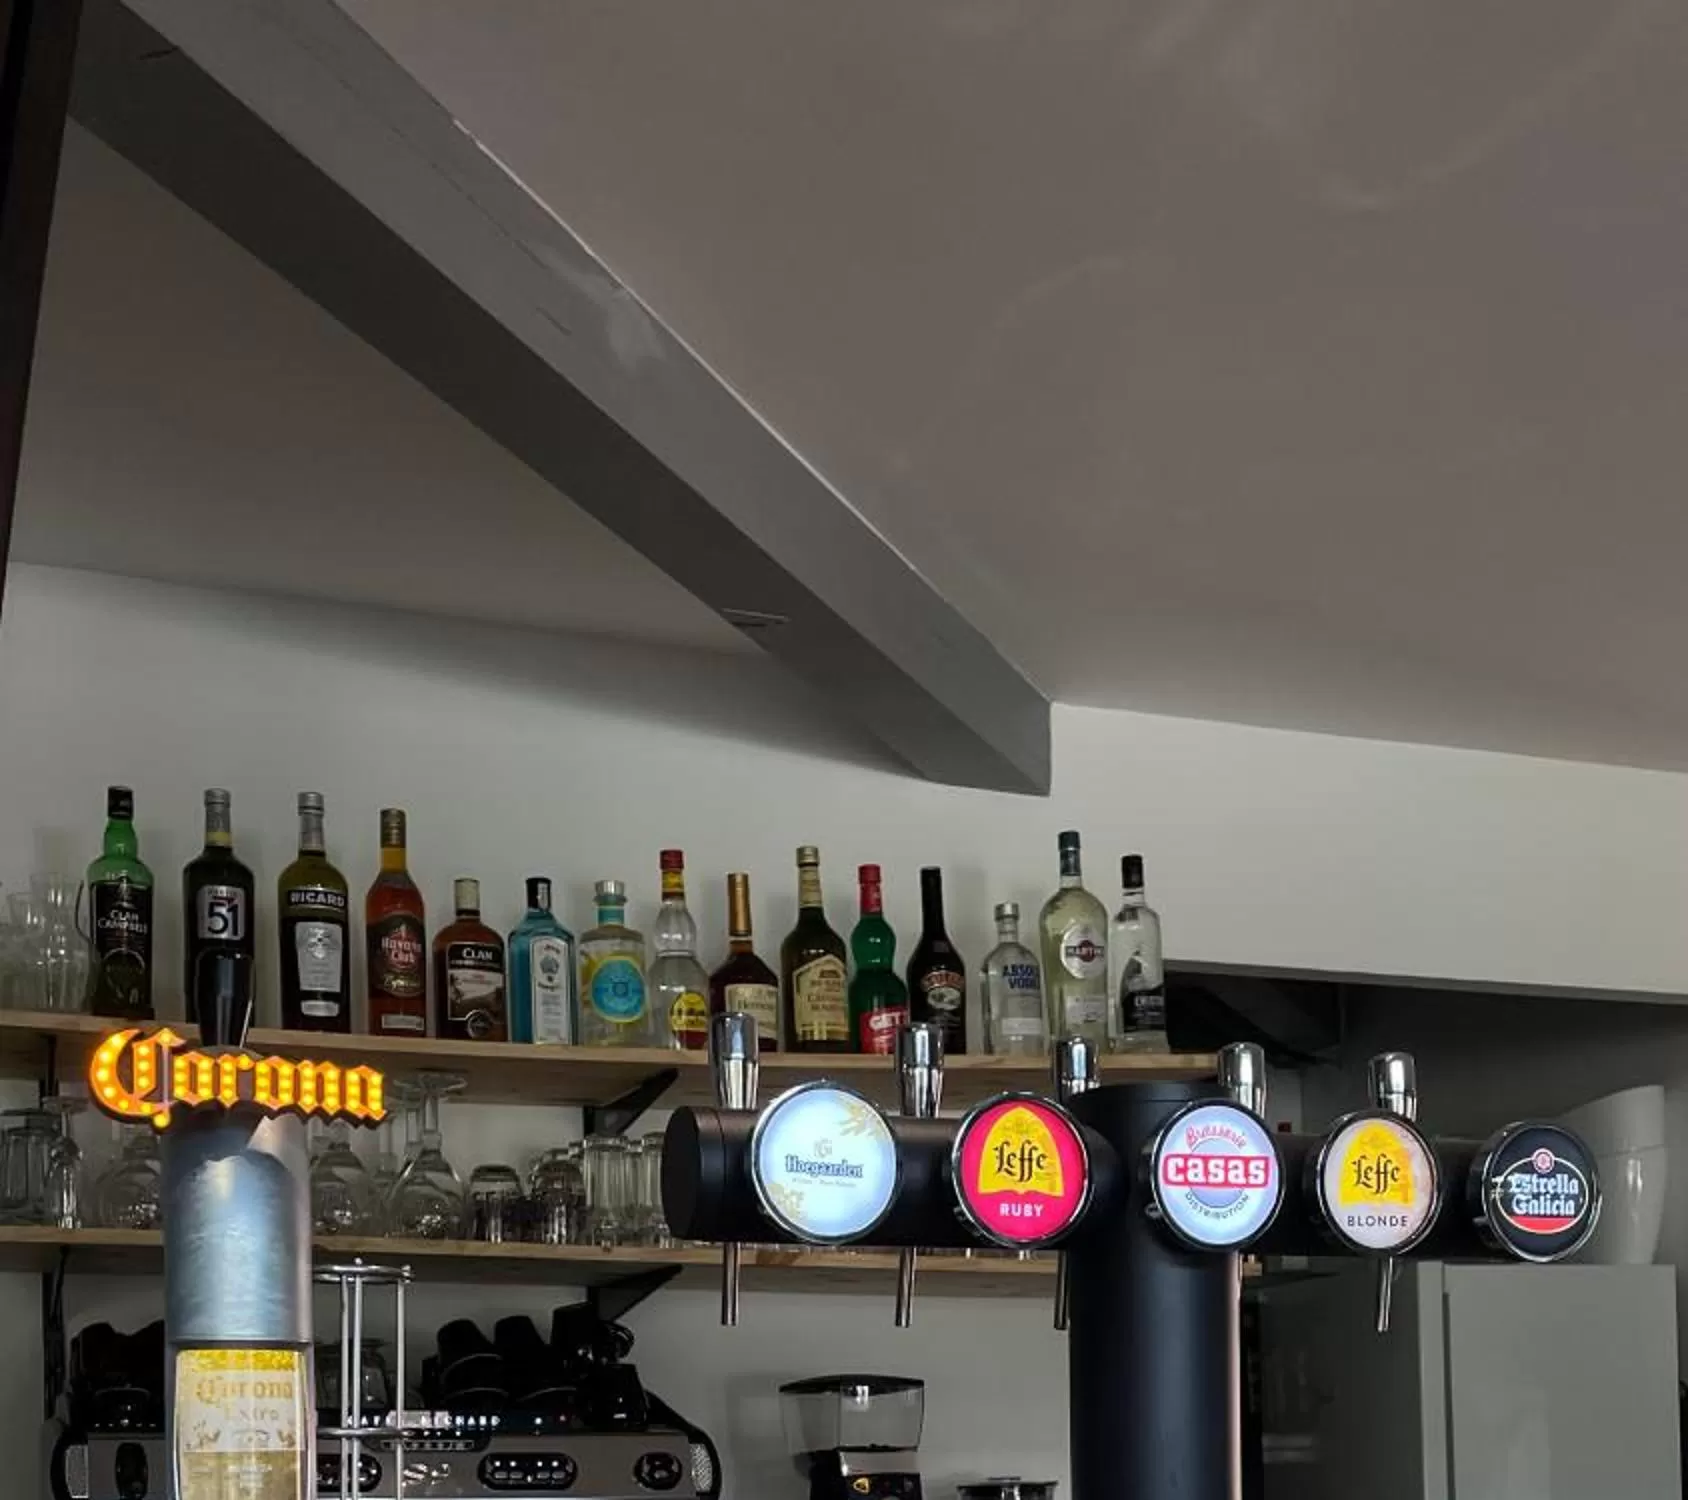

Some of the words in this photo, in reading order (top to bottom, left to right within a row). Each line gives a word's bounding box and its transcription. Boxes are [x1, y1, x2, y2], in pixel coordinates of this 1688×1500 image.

[291, 890, 345, 908] RICARD
[207, 901, 239, 937] 51
[462, 947, 493, 960] CLAN
[89, 1027, 388, 1133] Corona
[785, 1153, 865, 1178] Hoegaarden
[993, 1139, 1049, 1183] Leffe
[1351, 1153, 1401, 1195] Leffe
[1508, 1172, 1580, 1195] Estrella
[1000, 1203, 1044, 1217] RUBY
[1511, 1193, 1576, 1217] Galicia
[1347, 1215, 1409, 1227] BLONDE
